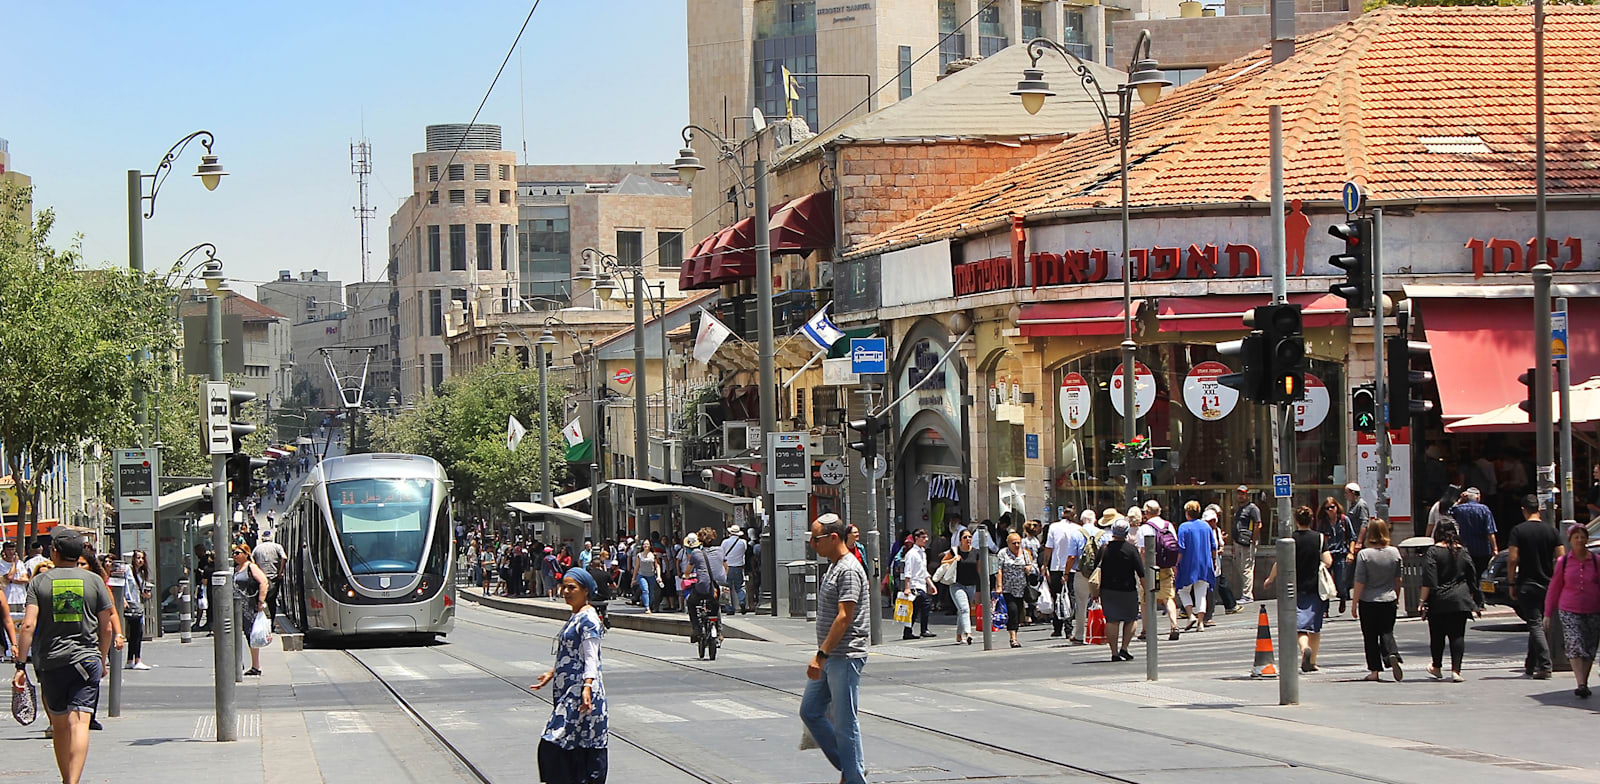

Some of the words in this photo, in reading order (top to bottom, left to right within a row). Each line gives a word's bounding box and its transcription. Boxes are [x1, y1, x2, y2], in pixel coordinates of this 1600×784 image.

[1029, 248, 1108, 296] נאמן
[1121, 242, 1261, 280] מאפה
[1464, 236, 1583, 280] נאמן
[823, 472, 843, 480] adidas
[1276, 477, 1289, 486] 25
